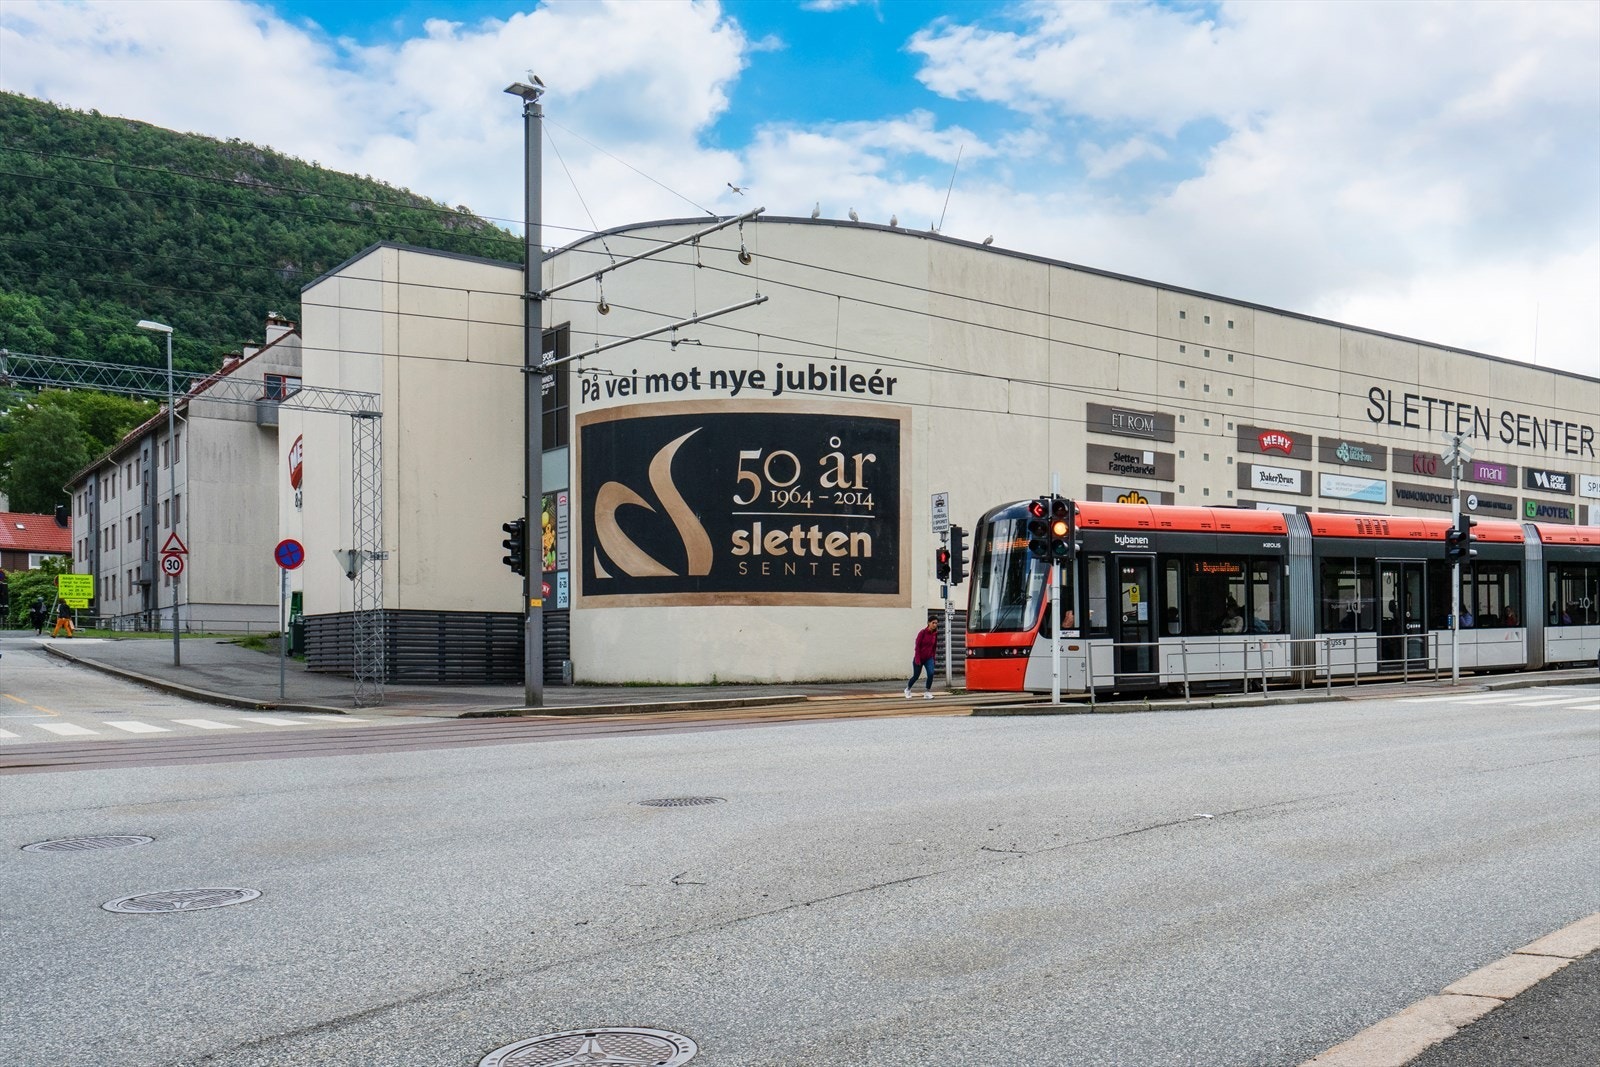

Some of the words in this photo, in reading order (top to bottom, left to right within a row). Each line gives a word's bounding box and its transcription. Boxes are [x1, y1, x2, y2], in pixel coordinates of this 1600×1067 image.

[581, 374, 599, 403] På
[605, 369, 638, 397] vei
[645, 367, 701, 394] mot
[709, 369, 766, 397] nye
[772, 363, 897, 396] jubileér
[1112, 413, 1124, 428] ET
[1128, 418, 1153, 431] ROM
[1367, 386, 1490, 441] SLETTEN
[1499, 410, 1595, 458] SENTER
[1262, 435, 1291, 449] MENY
[1113, 452, 1139, 464] Sletten
[1412, 452, 1437, 475] Kid
[733, 447, 801, 505] 50
[819, 436, 877, 490] år
[1109, 461, 1155, 475] Fargehandel
[1479, 466, 1503, 481] mani
[1549, 474, 1565, 483] SPORT
[1549, 481, 1567, 491] NORGE
[770, 485, 813, 510] 1964
[833, 492, 875, 511] 2014
[1395, 488, 1453, 505] VINMONOPOLET
[1536, 504, 1569, 519] APOTEK
[731, 522, 872, 558] sletten
[1114, 534, 1149, 545] bybanen
[166, 560, 180, 571] 30
[738, 562, 863, 577] SENTER
